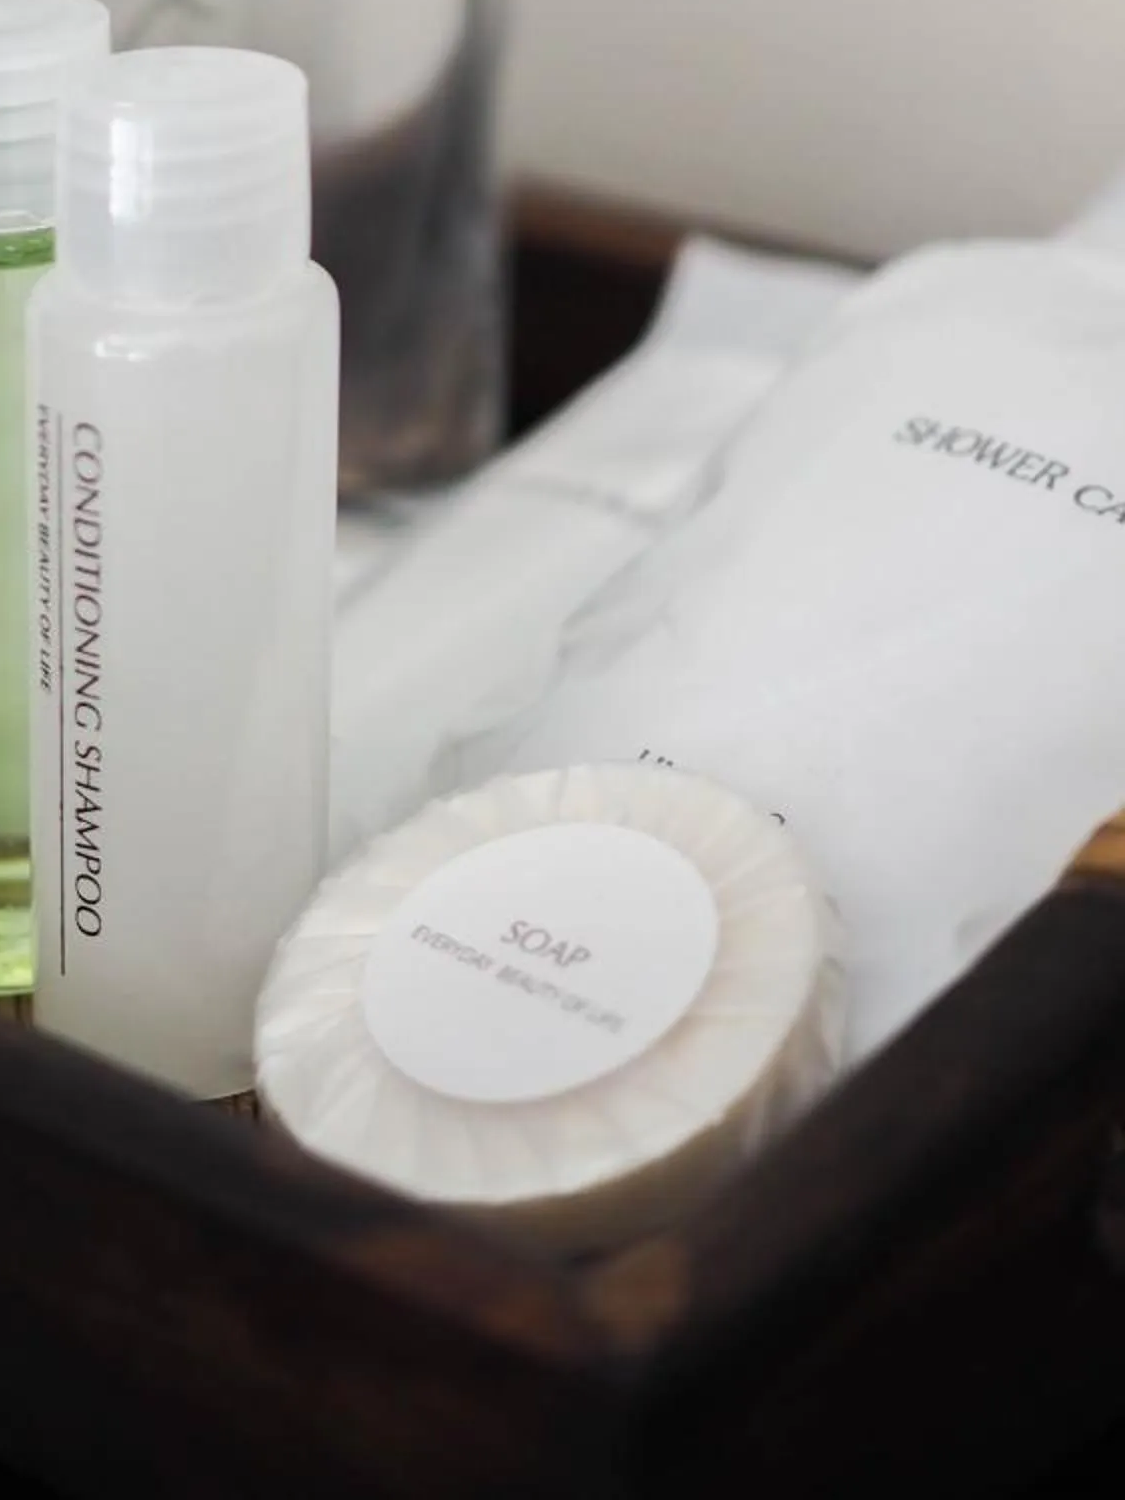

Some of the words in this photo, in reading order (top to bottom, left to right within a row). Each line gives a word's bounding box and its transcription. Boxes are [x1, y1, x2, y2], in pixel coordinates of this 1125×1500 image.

[892, 414, 1071, 491] SHOWER
[72, 421, 103, 731] CONDITIONING
[73, 740, 103, 938] SHAMPOO
[499, 919, 593, 968] SOAP
